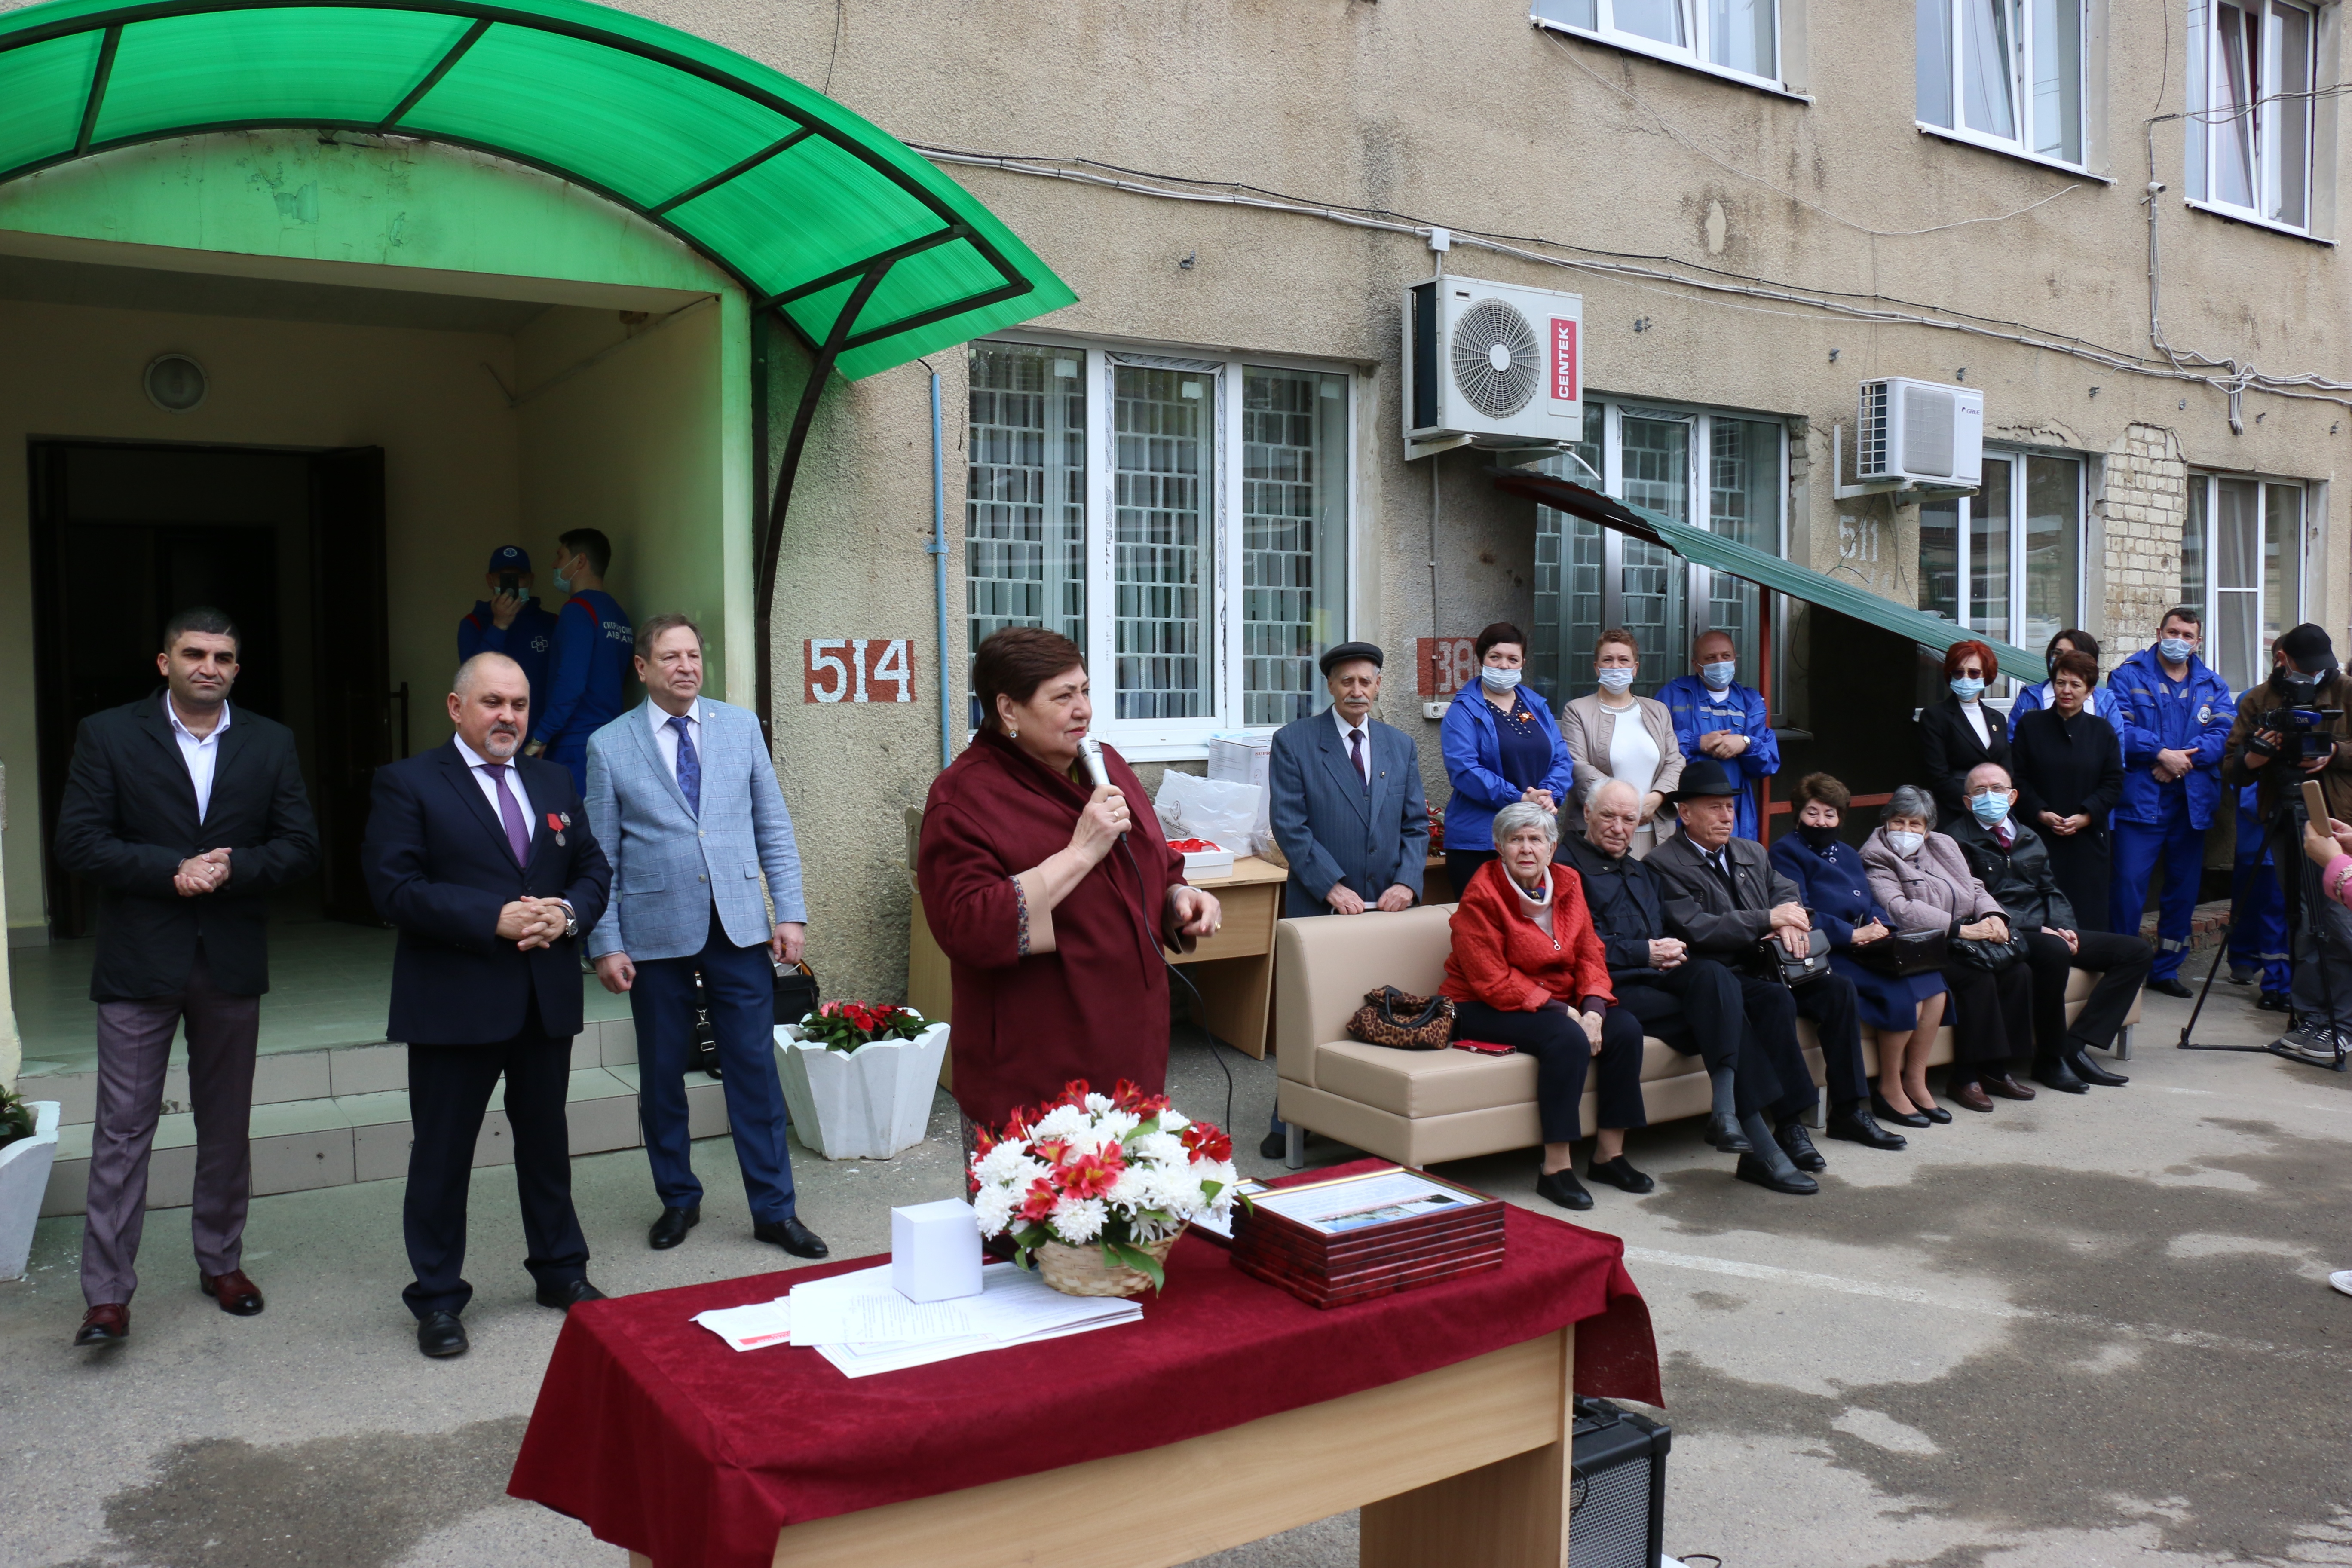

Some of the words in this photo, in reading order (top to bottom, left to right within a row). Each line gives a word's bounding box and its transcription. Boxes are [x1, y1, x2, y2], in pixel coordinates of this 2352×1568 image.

[1559, 326, 1569, 398] CENTEK
[1839, 515, 1878, 562] 511
[811, 639, 911, 702] 514
